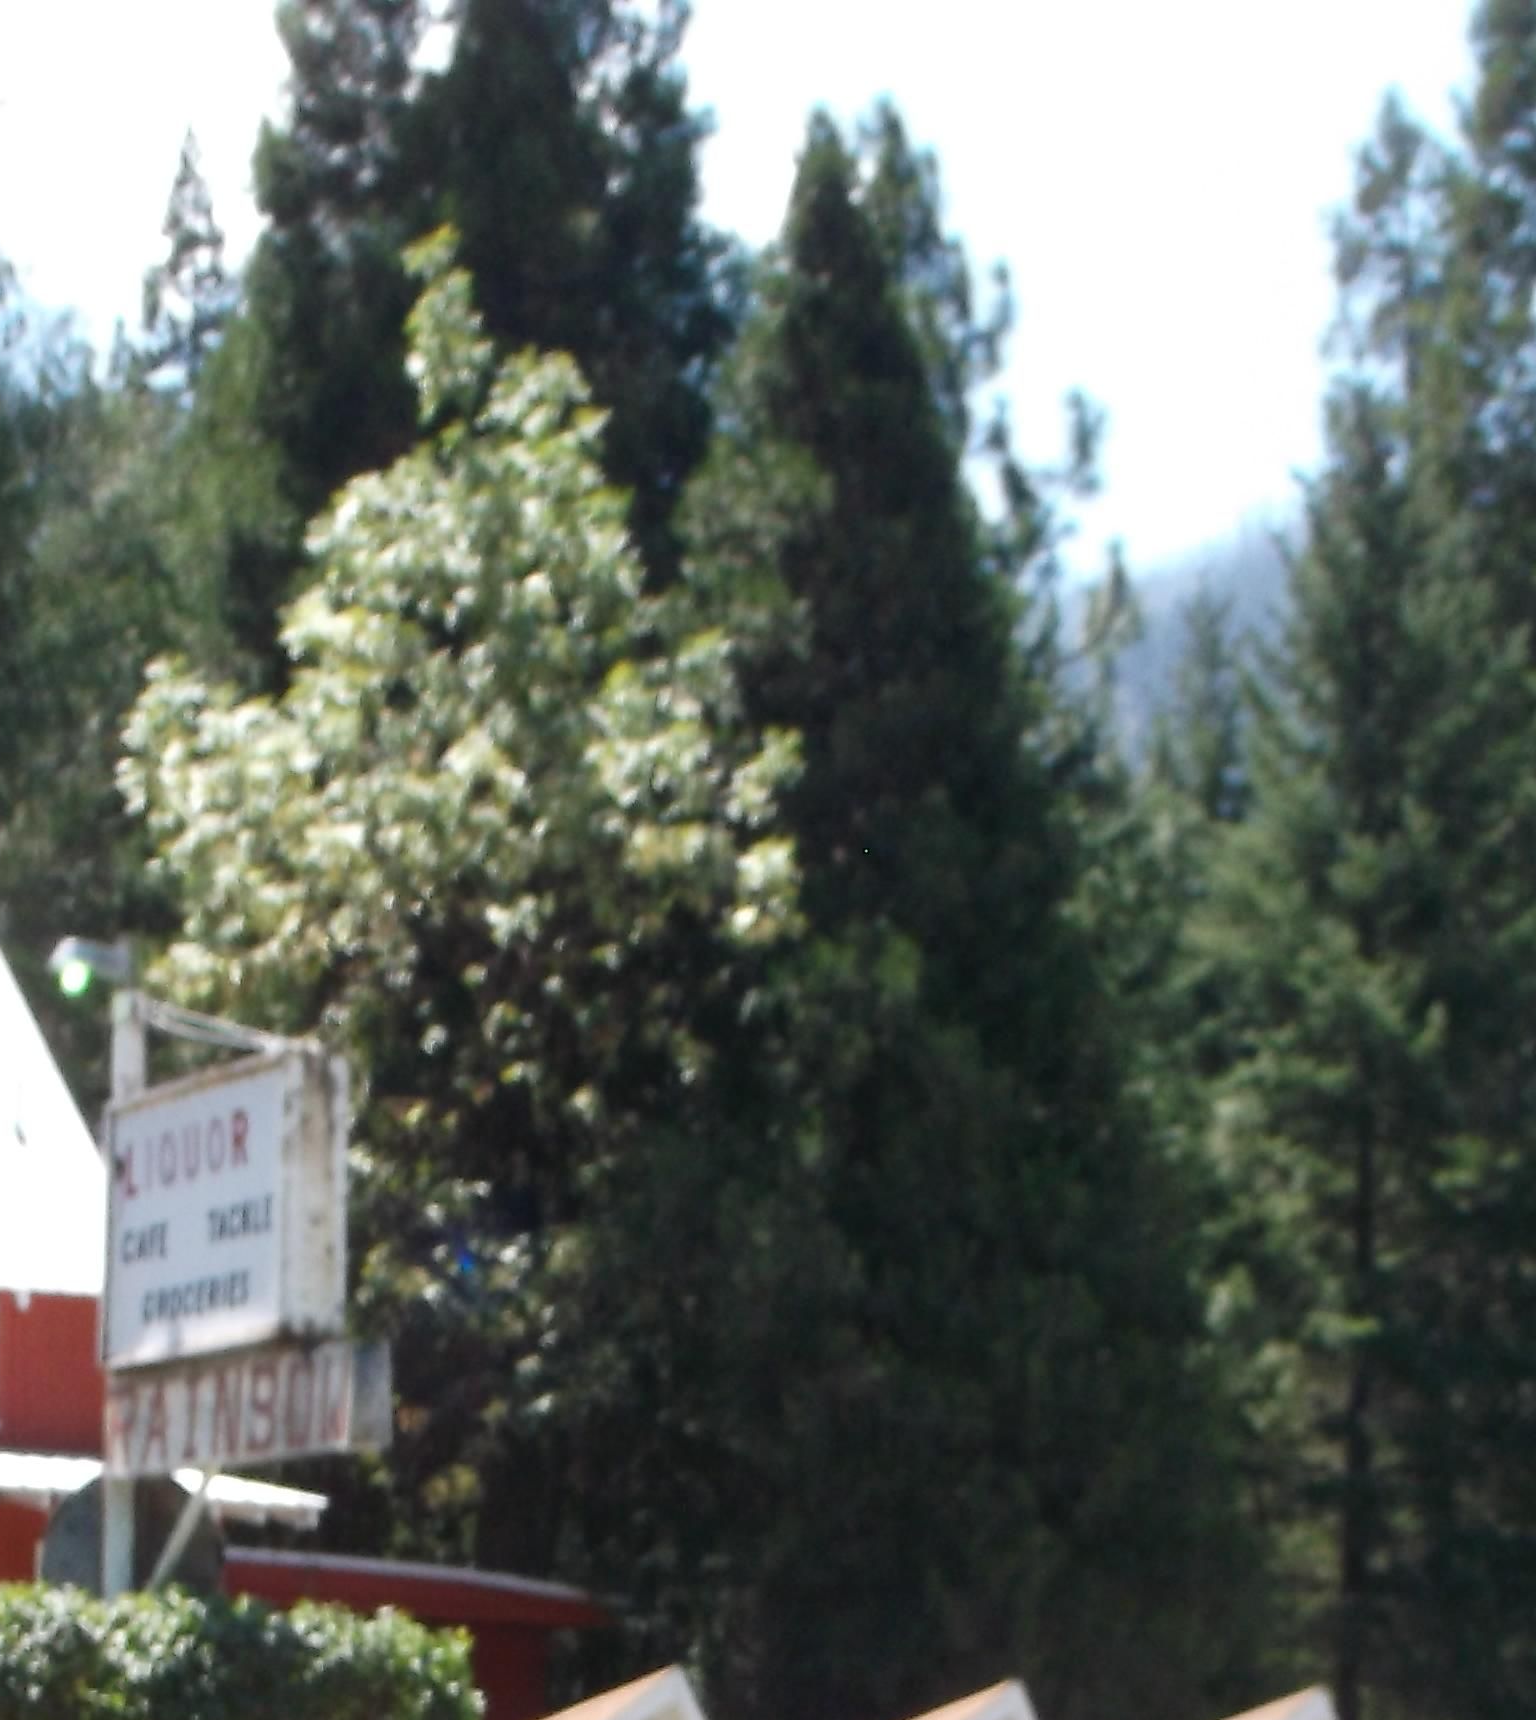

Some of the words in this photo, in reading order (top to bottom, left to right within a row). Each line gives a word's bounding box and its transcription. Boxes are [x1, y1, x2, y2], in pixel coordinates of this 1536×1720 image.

[121, 1108, 249, 1198] LIQUOR
[122, 1221, 168, 1264] CAFE
[208, 1194, 273, 1244] TACKLE
[143, 1271, 250, 1325] GROCERIES
